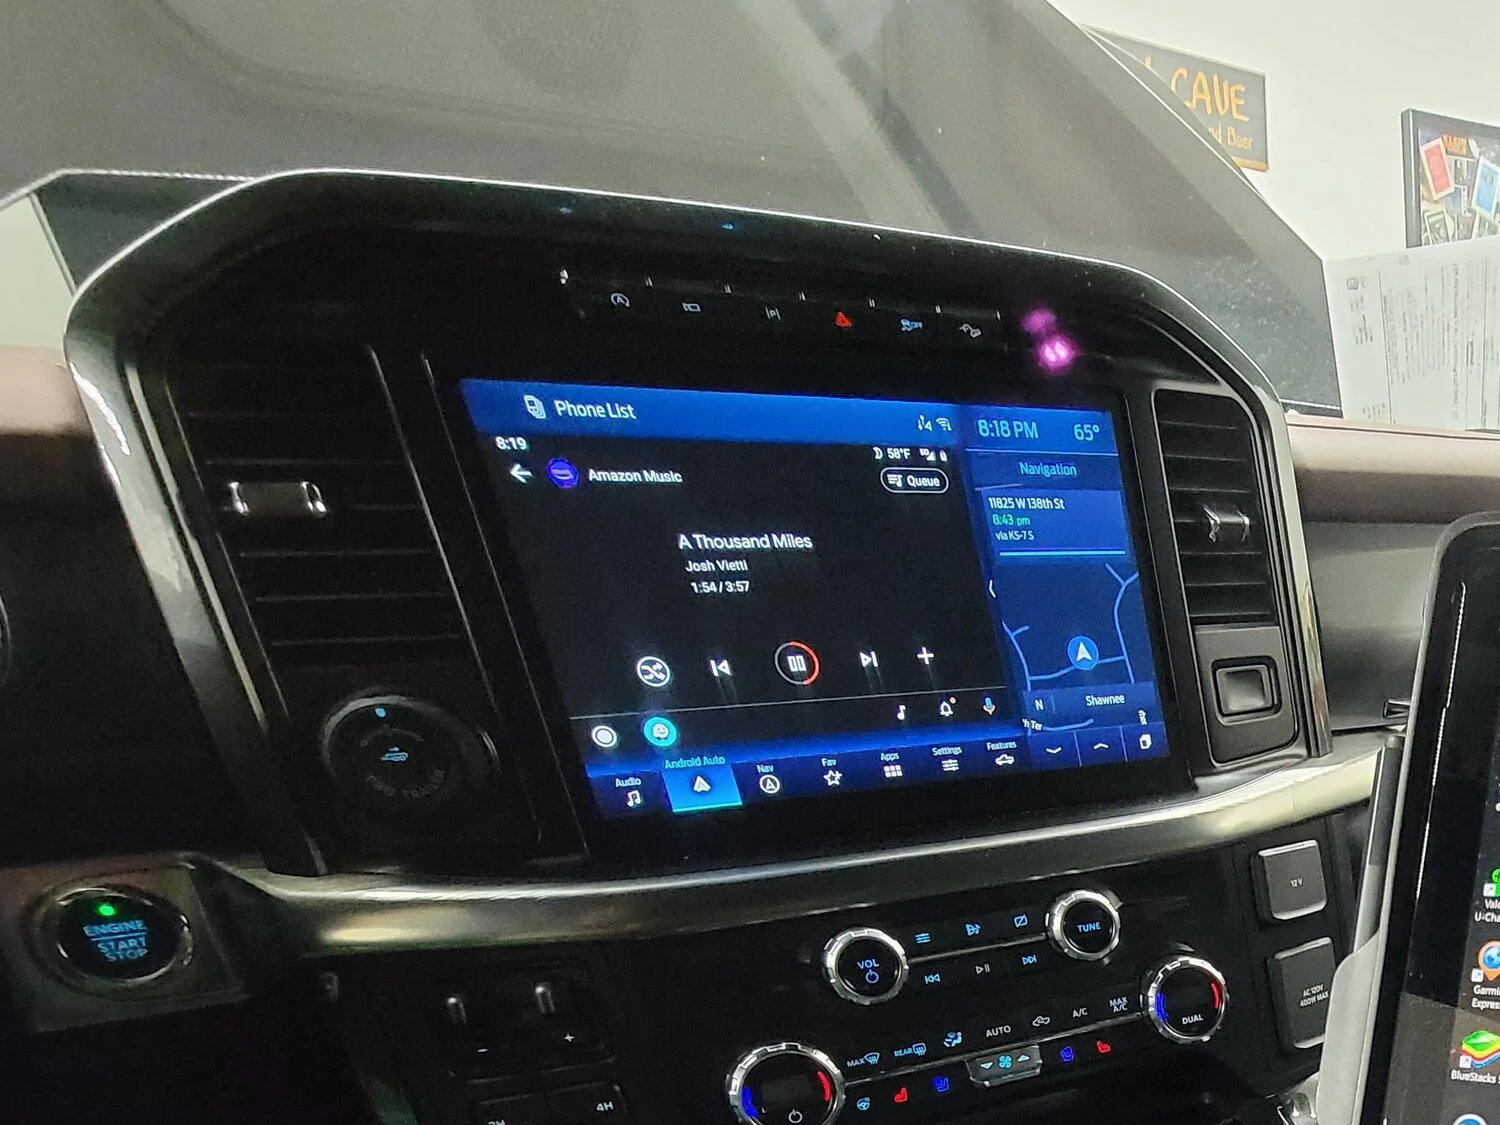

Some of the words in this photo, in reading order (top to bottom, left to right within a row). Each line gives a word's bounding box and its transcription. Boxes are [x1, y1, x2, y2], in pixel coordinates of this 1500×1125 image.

[1171, 68, 1249, 121] CAVE
[554, 400, 606, 418] Phone
[609, 402, 637, 419] List
[978, 419, 1011, 438] 8:18
[1014, 421, 1038, 439] PM
[496, 437, 527, 450] 8:19
[1020, 462, 1077, 477] Navigation
[588, 469, 642, 482] Amazon
[645, 470, 683, 483] Music
[907, 476, 940, 488] Queue
[989, 498, 1014, 509] 11825
[1015, 498, 1026, 509] W
[1027, 498, 1052, 509] 138th
[1054, 498, 1065, 510] St
[993, 514, 1014, 525] 8:43
[1017, 517, 1030, 527] pm
[678, 535, 692, 549] A
[695, 534, 770, 550] Thousand
[773, 535, 813, 549] Miles
[686, 560, 714, 572] Josh
[716, 560, 748, 571] Vietti
[691, 581, 717, 593] 1:54
[726, 580, 749, 593] 3:57
[1035, 699, 1044, 710] N
[1086, 695, 1125, 706] Shawnee
[932, 746, 962, 756] Settings
[987, 740, 1016, 750] Features
[665, 756, 700, 769] Android
[703, 755, 725, 766] Auto
[822, 758, 837, 767] Fav
[880, 752, 899, 761] Apps
[757, 764, 774, 773] Nav
[615, 776, 641, 788] Audio
[83, 919, 148, 937] ENGINE
[1077, 922, 1101, 933] TUNE
[98, 937, 147, 951] START
[105, 949, 148, 962] STOP
[857, 959, 880, 970] VOL
[1110, 997, 1127, 1007] MAX
[1113, 1003, 1128, 1013] A/C
[1072, 1007, 1087, 1018] A/C
[1182, 1014, 1204, 1025] DUAL
[986, 1024, 1011, 1038] AUTO
[894, 1046, 913, 1057] REAR
[847, 1056, 865, 1067] MAX
[597, 1102, 614, 1112] 4H
